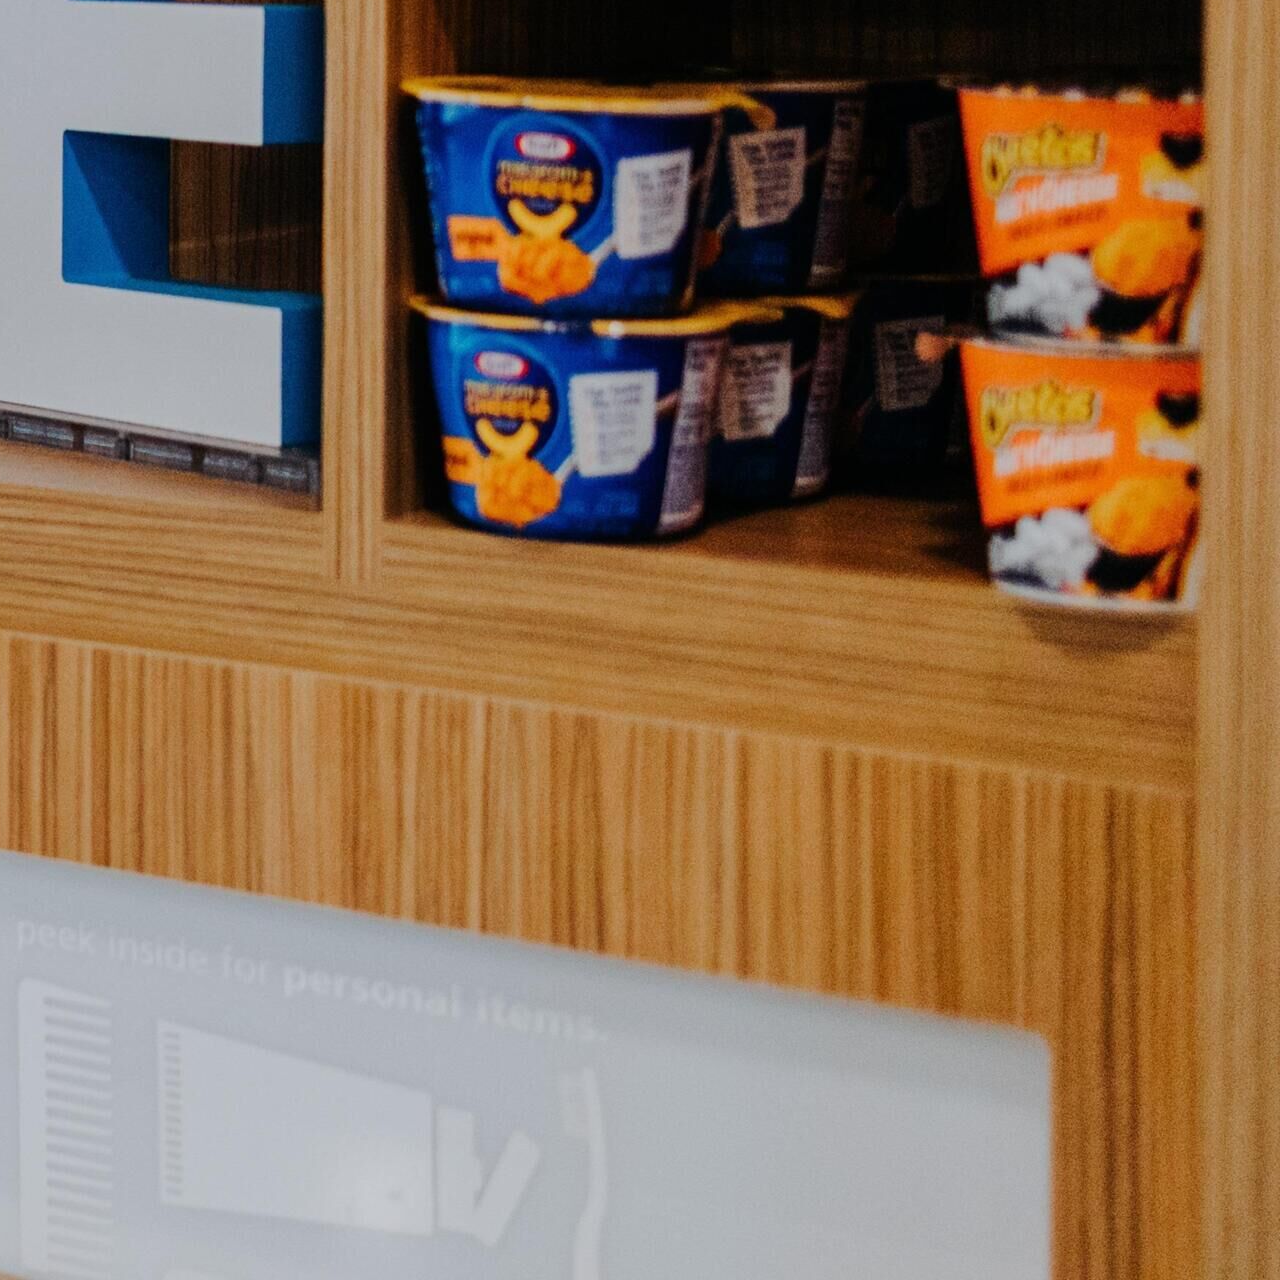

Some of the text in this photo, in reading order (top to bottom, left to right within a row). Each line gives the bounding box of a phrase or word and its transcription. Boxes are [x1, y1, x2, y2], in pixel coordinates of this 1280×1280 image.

[17, 915, 96, 955] peek
[109, 930, 209, 973] inside
[223, 941, 270, 984] for
[282, 960, 461, 1019] personal
